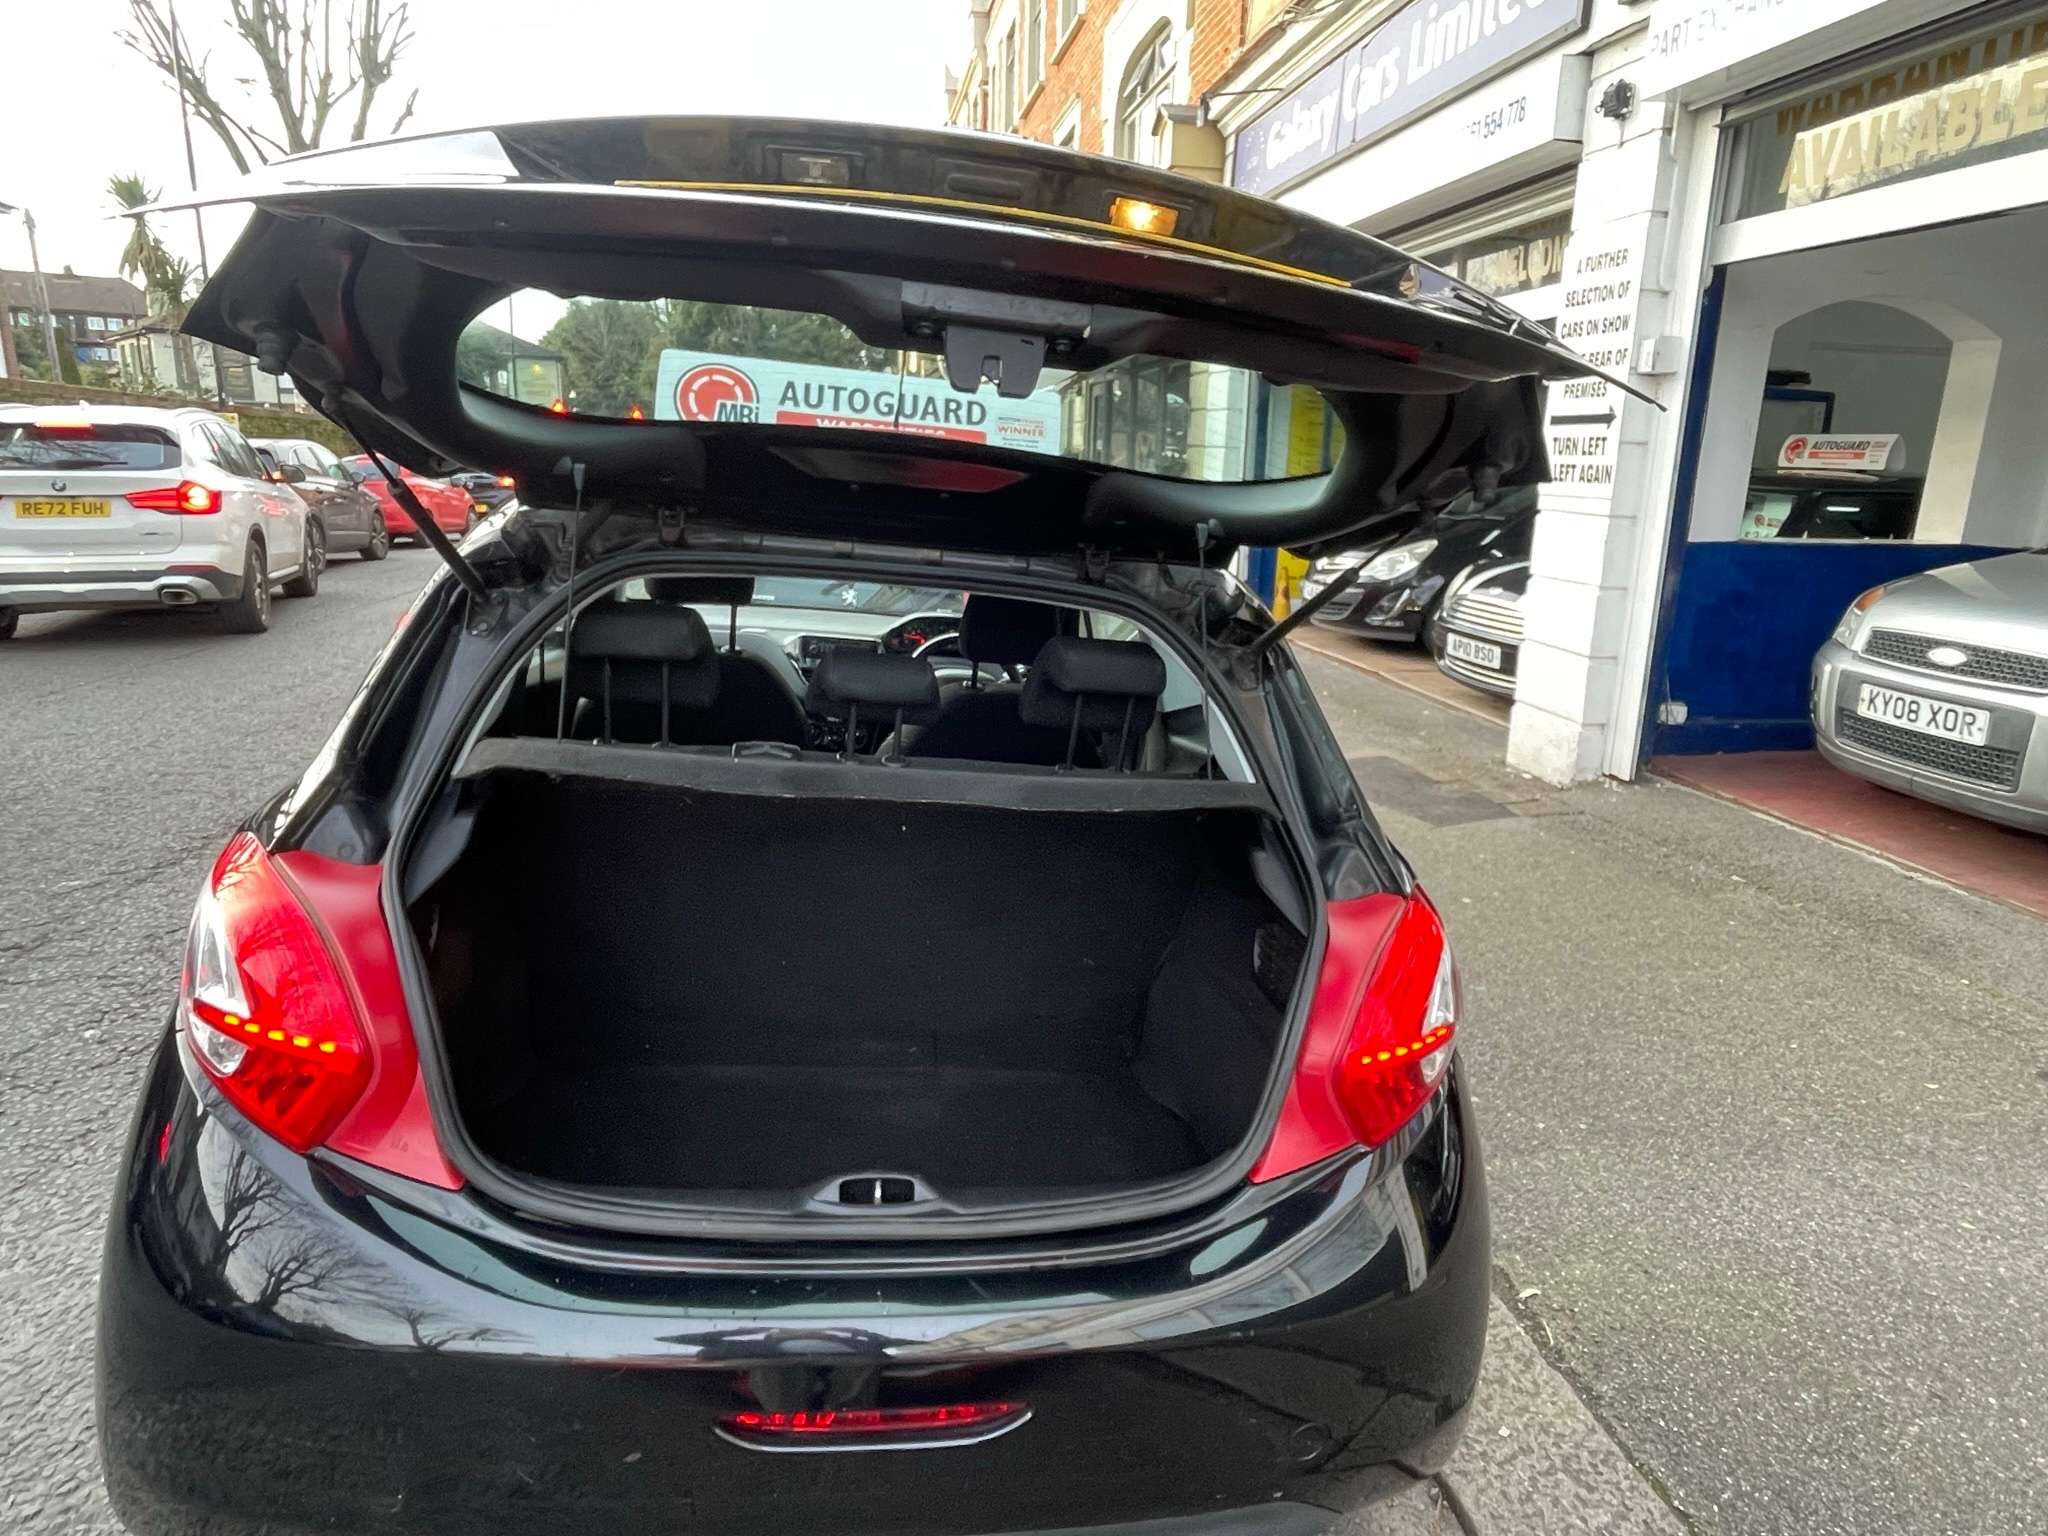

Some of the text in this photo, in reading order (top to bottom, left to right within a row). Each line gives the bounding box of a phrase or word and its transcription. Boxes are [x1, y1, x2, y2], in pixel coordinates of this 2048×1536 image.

[1407, 0, 1545, 85] Limite
[1777, 64, 2048, 194] AVAILABLE
[1576, 248, 1629, 275] A FURTHER
[1565, 280, 1632, 308] SELECTION OF
[1560, 313, 1632, 340] CARS ON SHOW
[1588, 349, 1613, 368] REAR
[1615, 347, 1629, 366] OF
[777, 379, 988, 427] AUTOGUARD
[1563, 380, 1608, 399] PREMISES
[1552, 436, 1608, 456] TURN LEFT
[1810, 440, 1871, 451] AUTOGUARD
[1552, 463, 1614, 484] LEFT AGAIN
[21, 501, 105, 516] RE72 FUH
[1867, 688, 1978, 737] KY08 XOR
